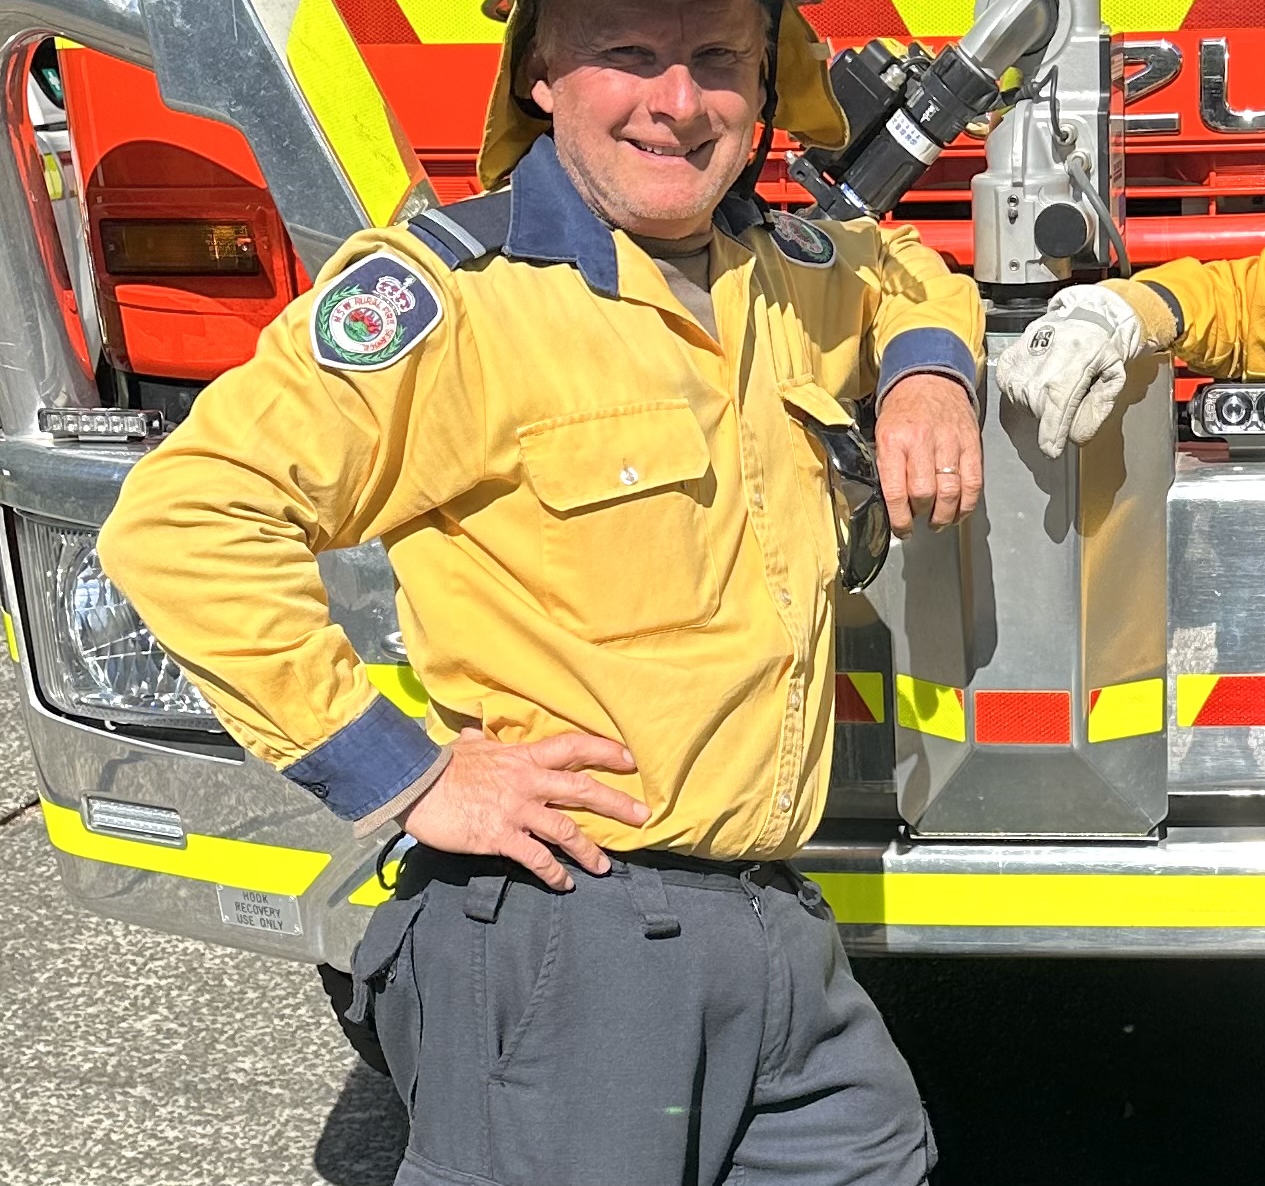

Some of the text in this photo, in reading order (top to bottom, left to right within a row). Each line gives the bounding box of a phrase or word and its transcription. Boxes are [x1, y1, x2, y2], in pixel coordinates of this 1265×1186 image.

[241, 891, 269, 904] HOOK
[234, 901, 281, 919] RECOVERY
[236, 914, 284, 931] USE ONLY
